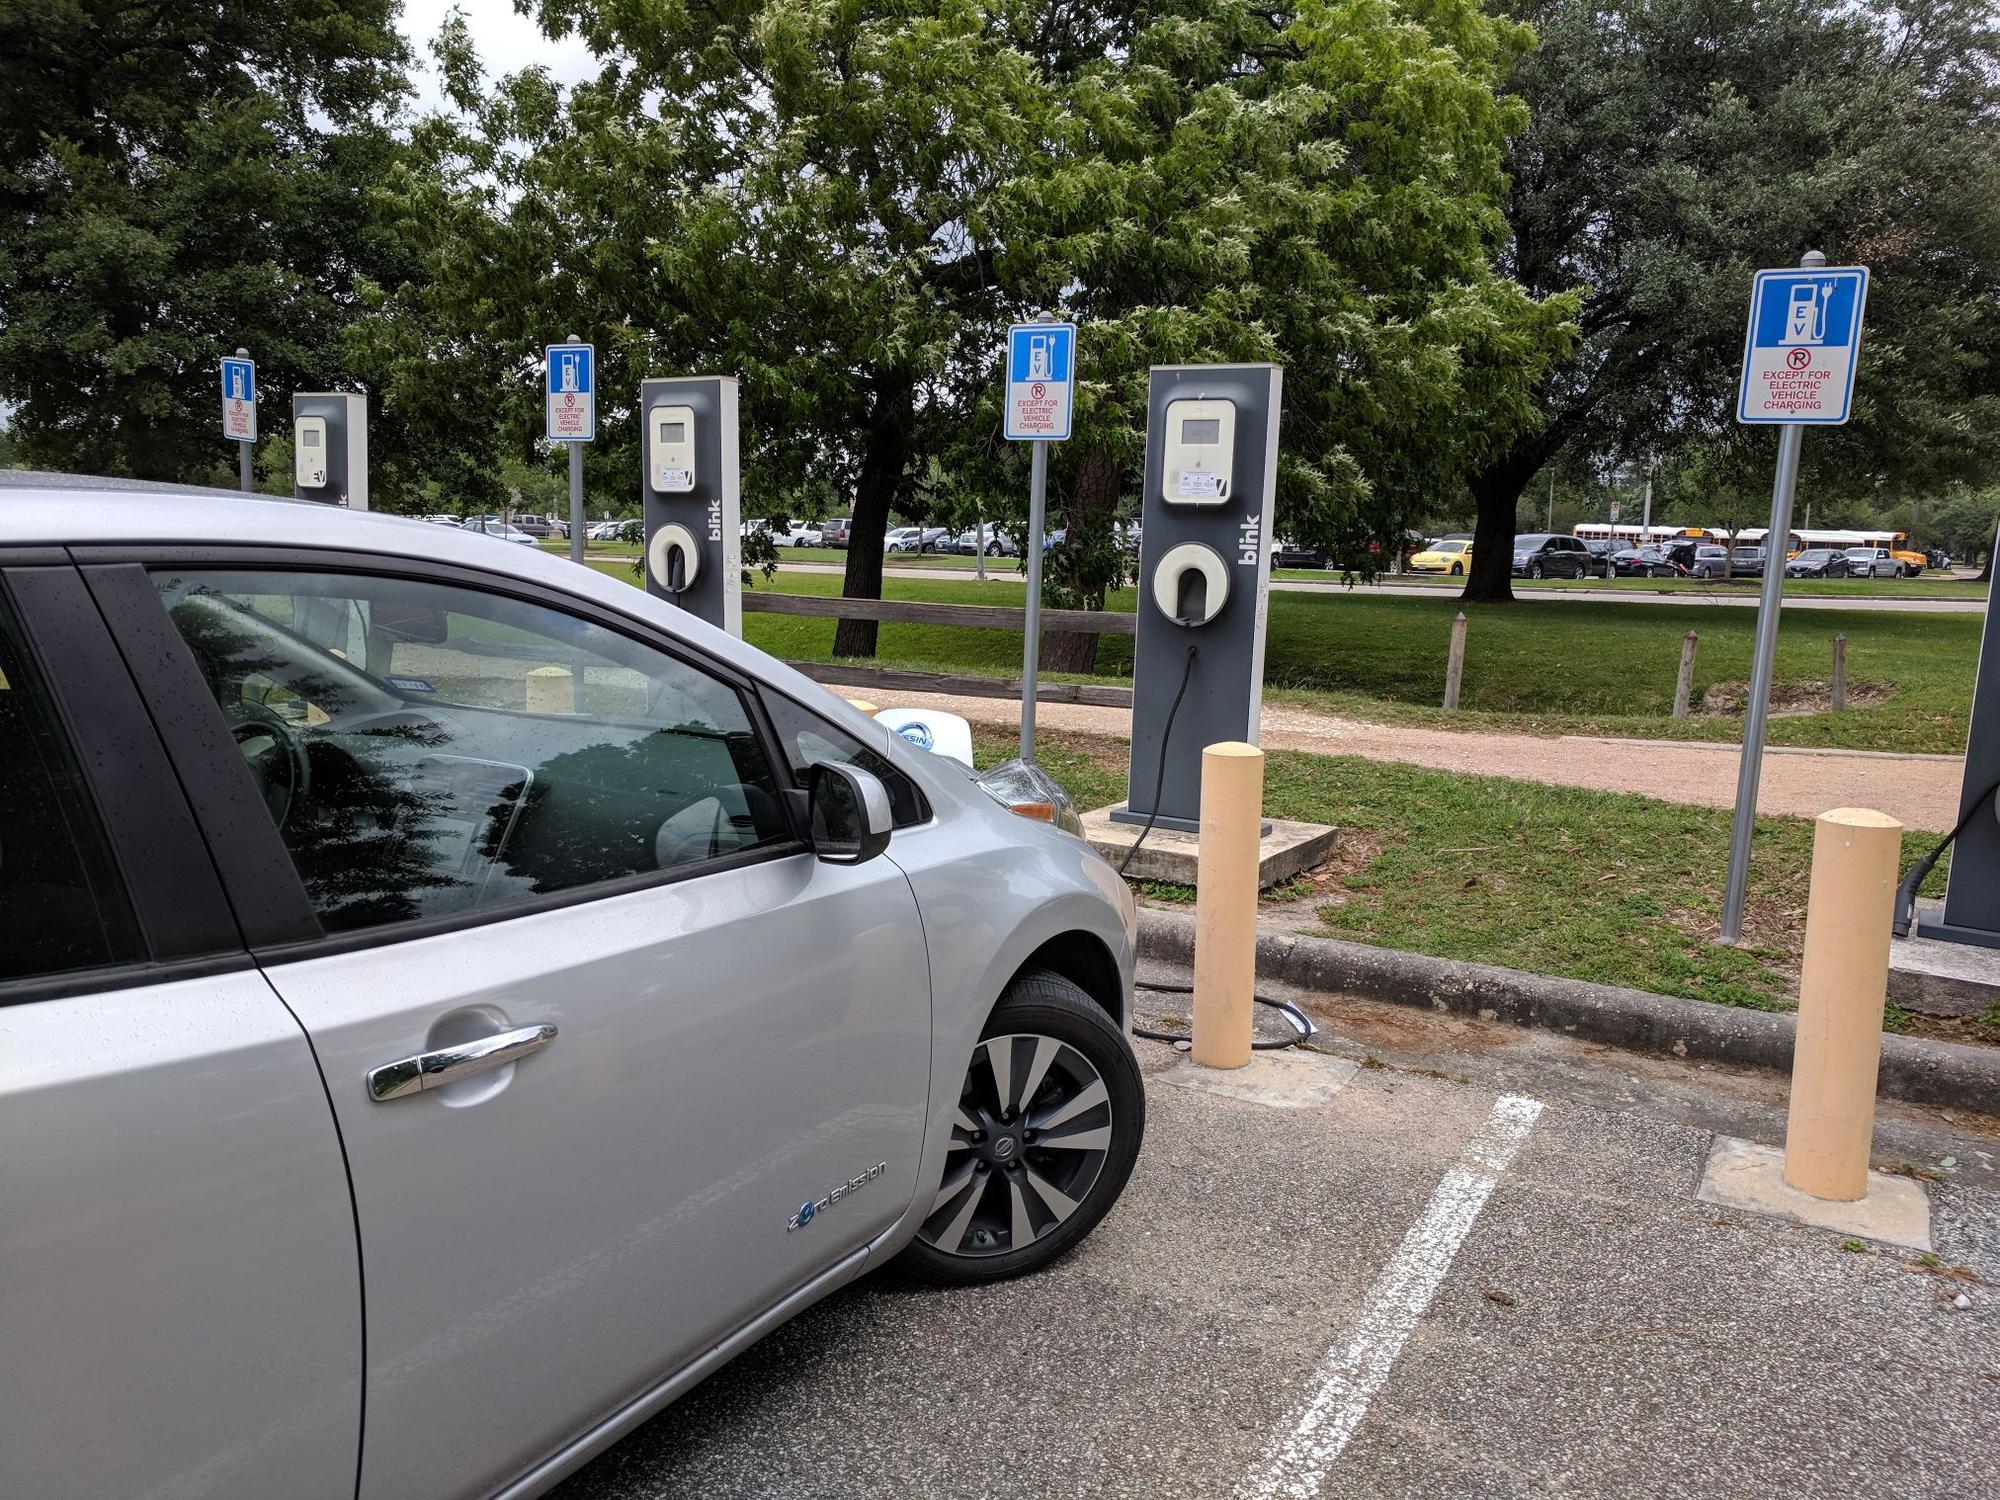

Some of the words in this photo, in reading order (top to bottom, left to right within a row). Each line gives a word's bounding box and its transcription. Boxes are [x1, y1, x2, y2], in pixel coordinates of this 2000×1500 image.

[1763, 371, 1806, 380] EXCEPT
[1808, 371, 1831, 380] FOR
[1769, 381, 1822, 390] ELECTRIC
[1771, 391, 1817, 400] VEHICLE
[1764, 401, 1822, 410] CHARGING
[1020, 422, 1054, 430] CHARGING
[708, 499, 721, 541] blink
[1238, 514, 1260, 565] blink
